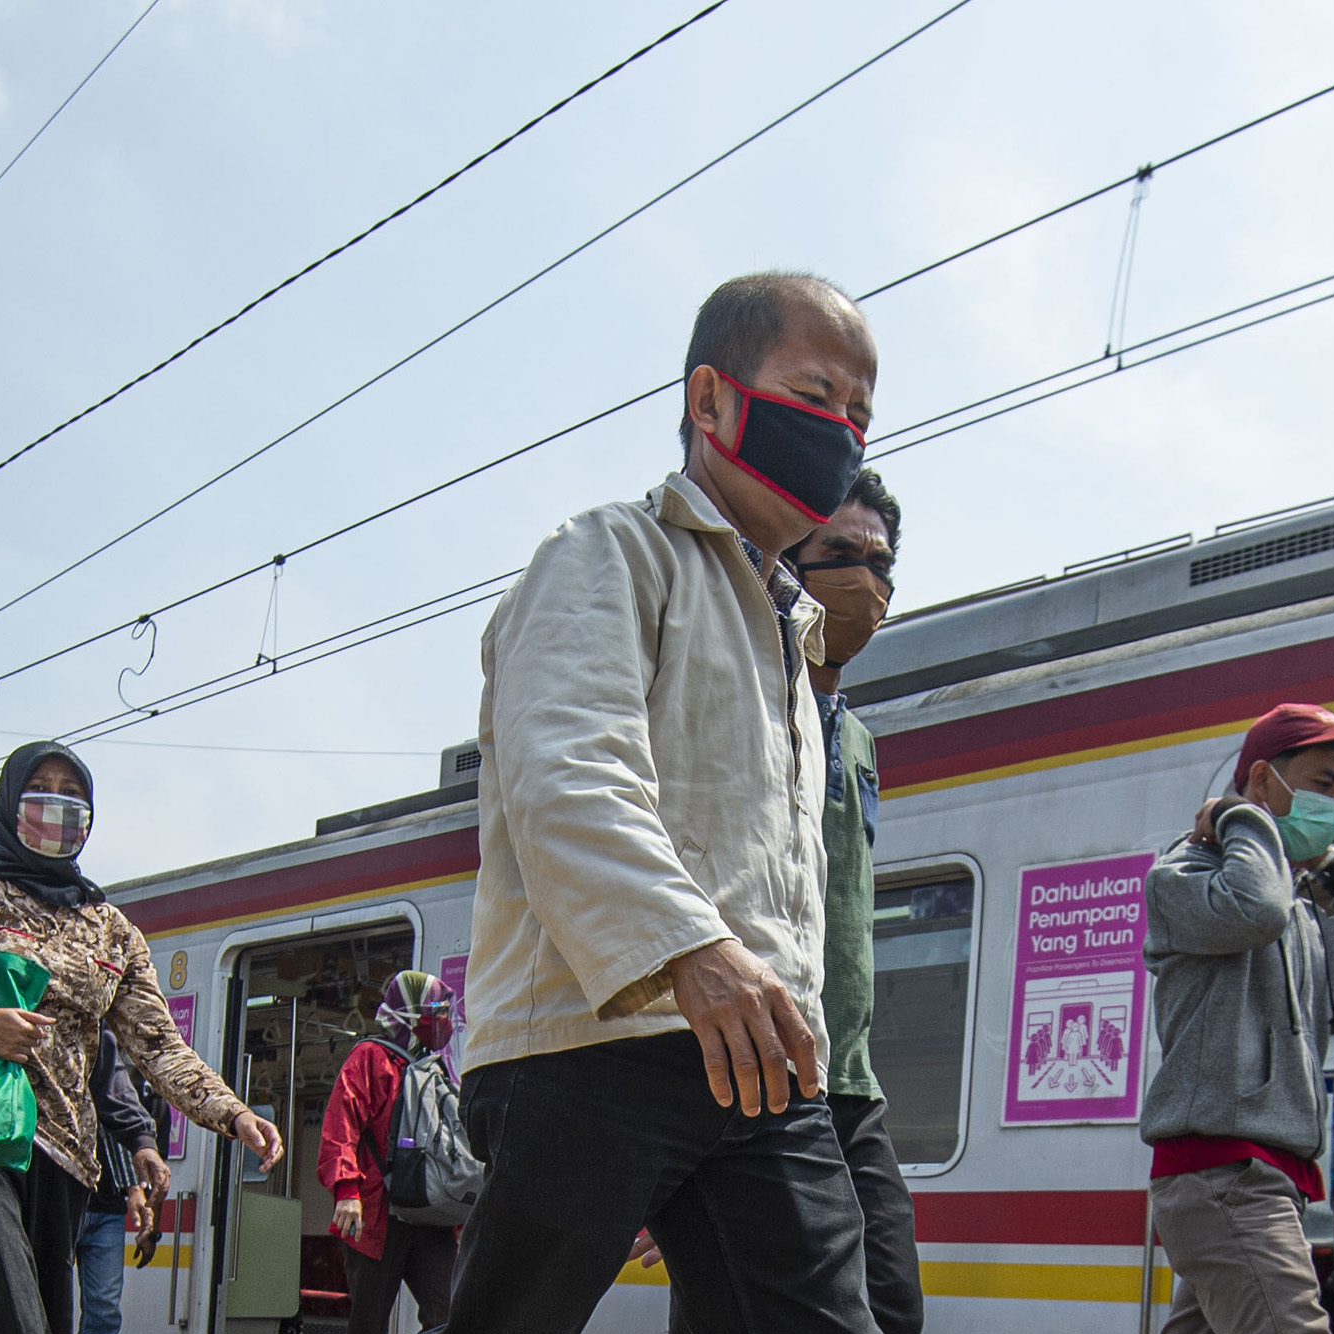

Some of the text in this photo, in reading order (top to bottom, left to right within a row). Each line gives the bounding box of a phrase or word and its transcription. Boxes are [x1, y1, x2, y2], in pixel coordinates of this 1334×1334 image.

[1030, 877, 1142, 905] Dahulukan
[1029, 903, 1140, 929] Penumpang
[1031, 928, 1134, 954] Yang Turun
[169, 950, 188, 990] 8
